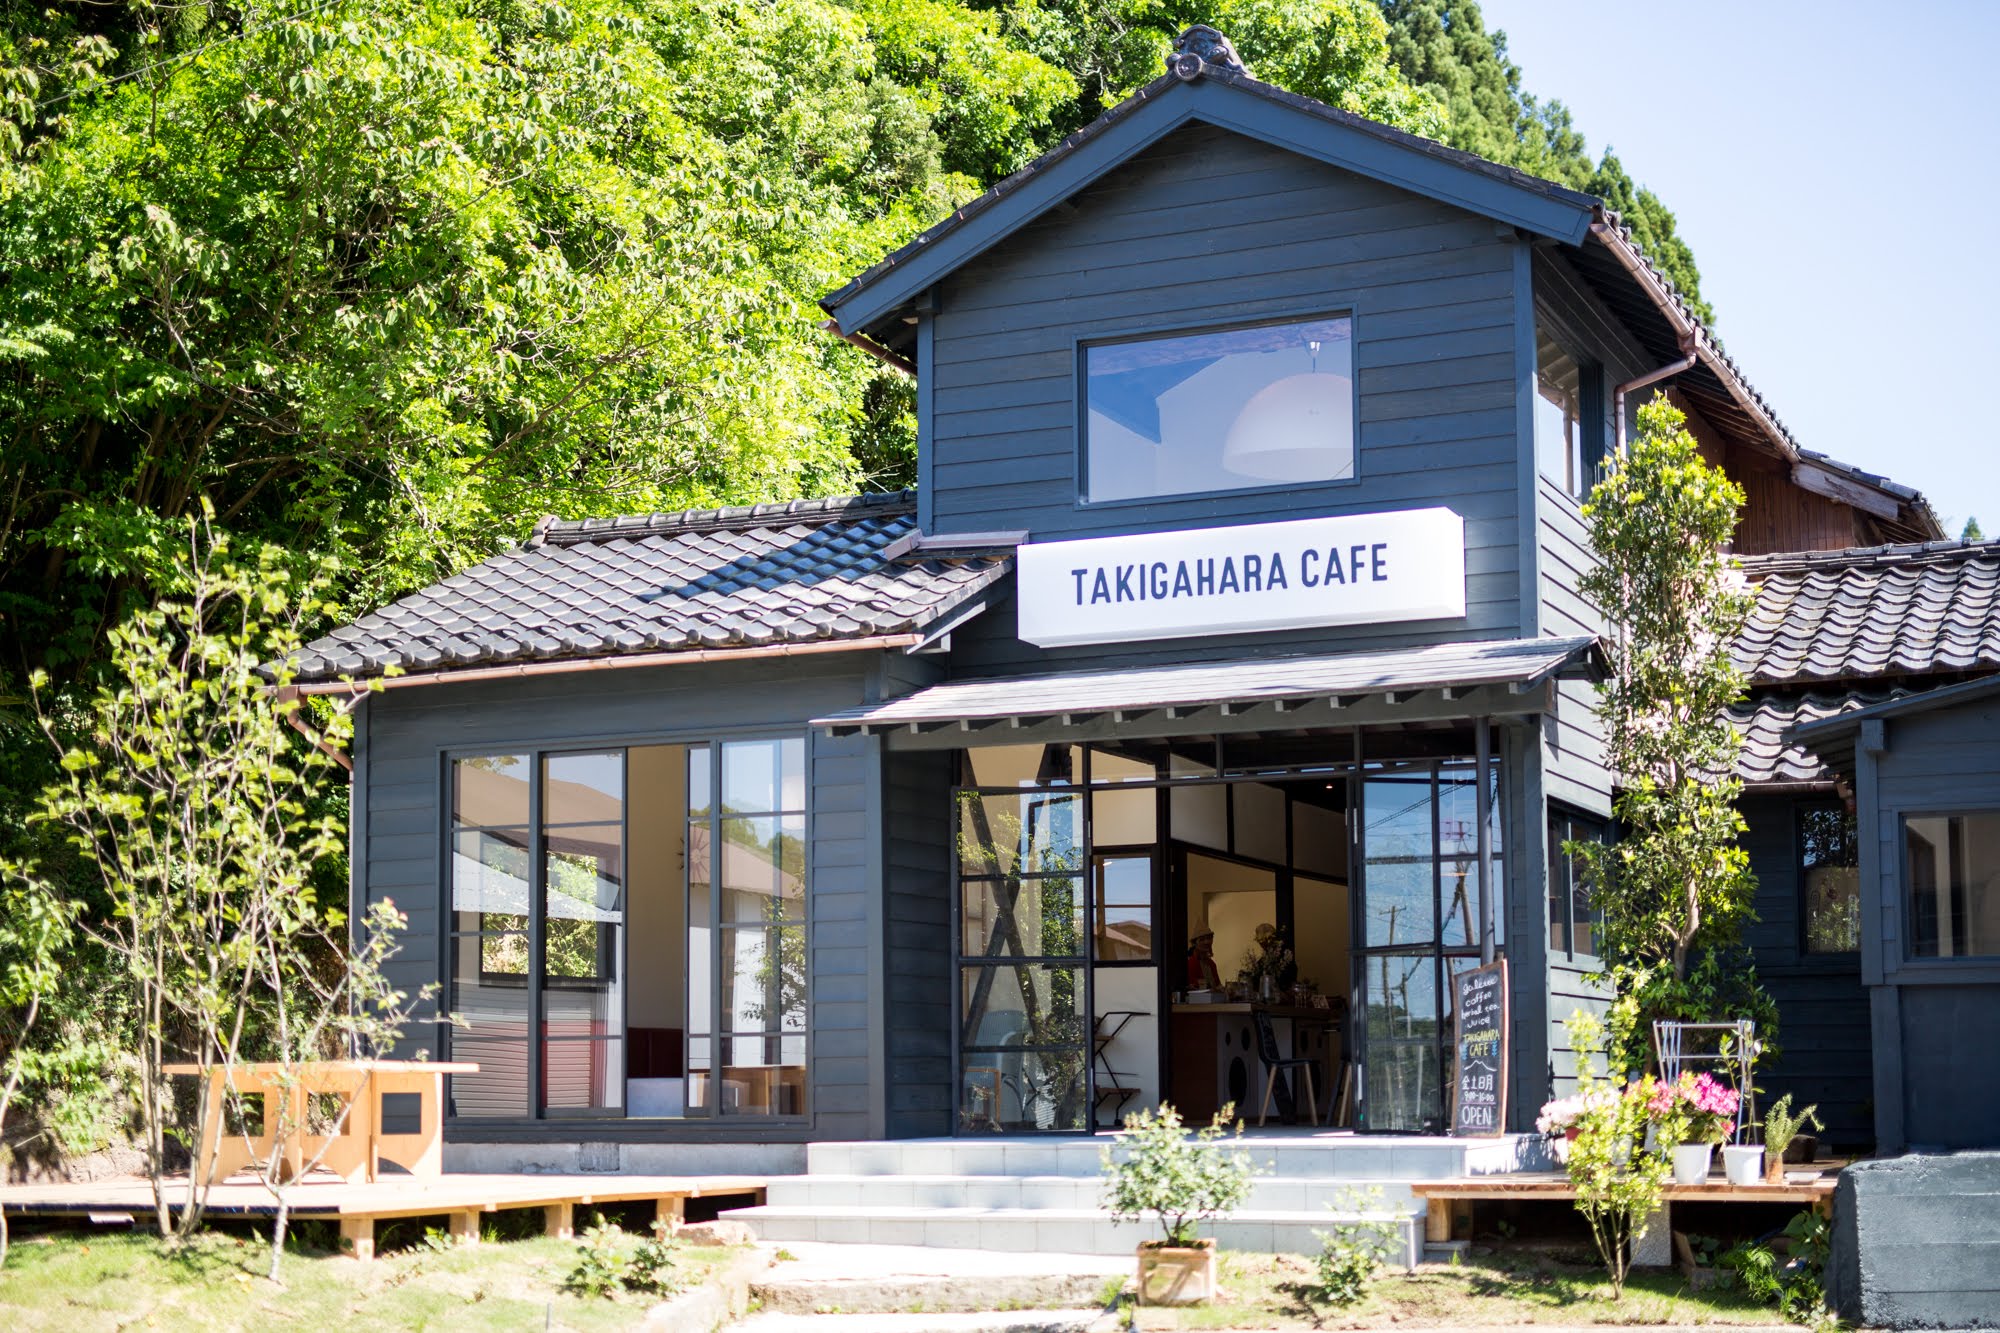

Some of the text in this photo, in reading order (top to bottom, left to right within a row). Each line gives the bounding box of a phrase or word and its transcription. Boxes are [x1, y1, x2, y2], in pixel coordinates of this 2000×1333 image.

[1071, 543, 1388, 606] TAKIGAHARA CAFE
[1465, 991, 1492, 1007] coffee
[1462, 1028, 1500, 1044] TAKIGAHARA
[1469, 1042, 1489, 1057] CAFE
[1462, 1075, 1493, 1091] 金土日月
[1462, 1105, 1493, 1125] OPEN
